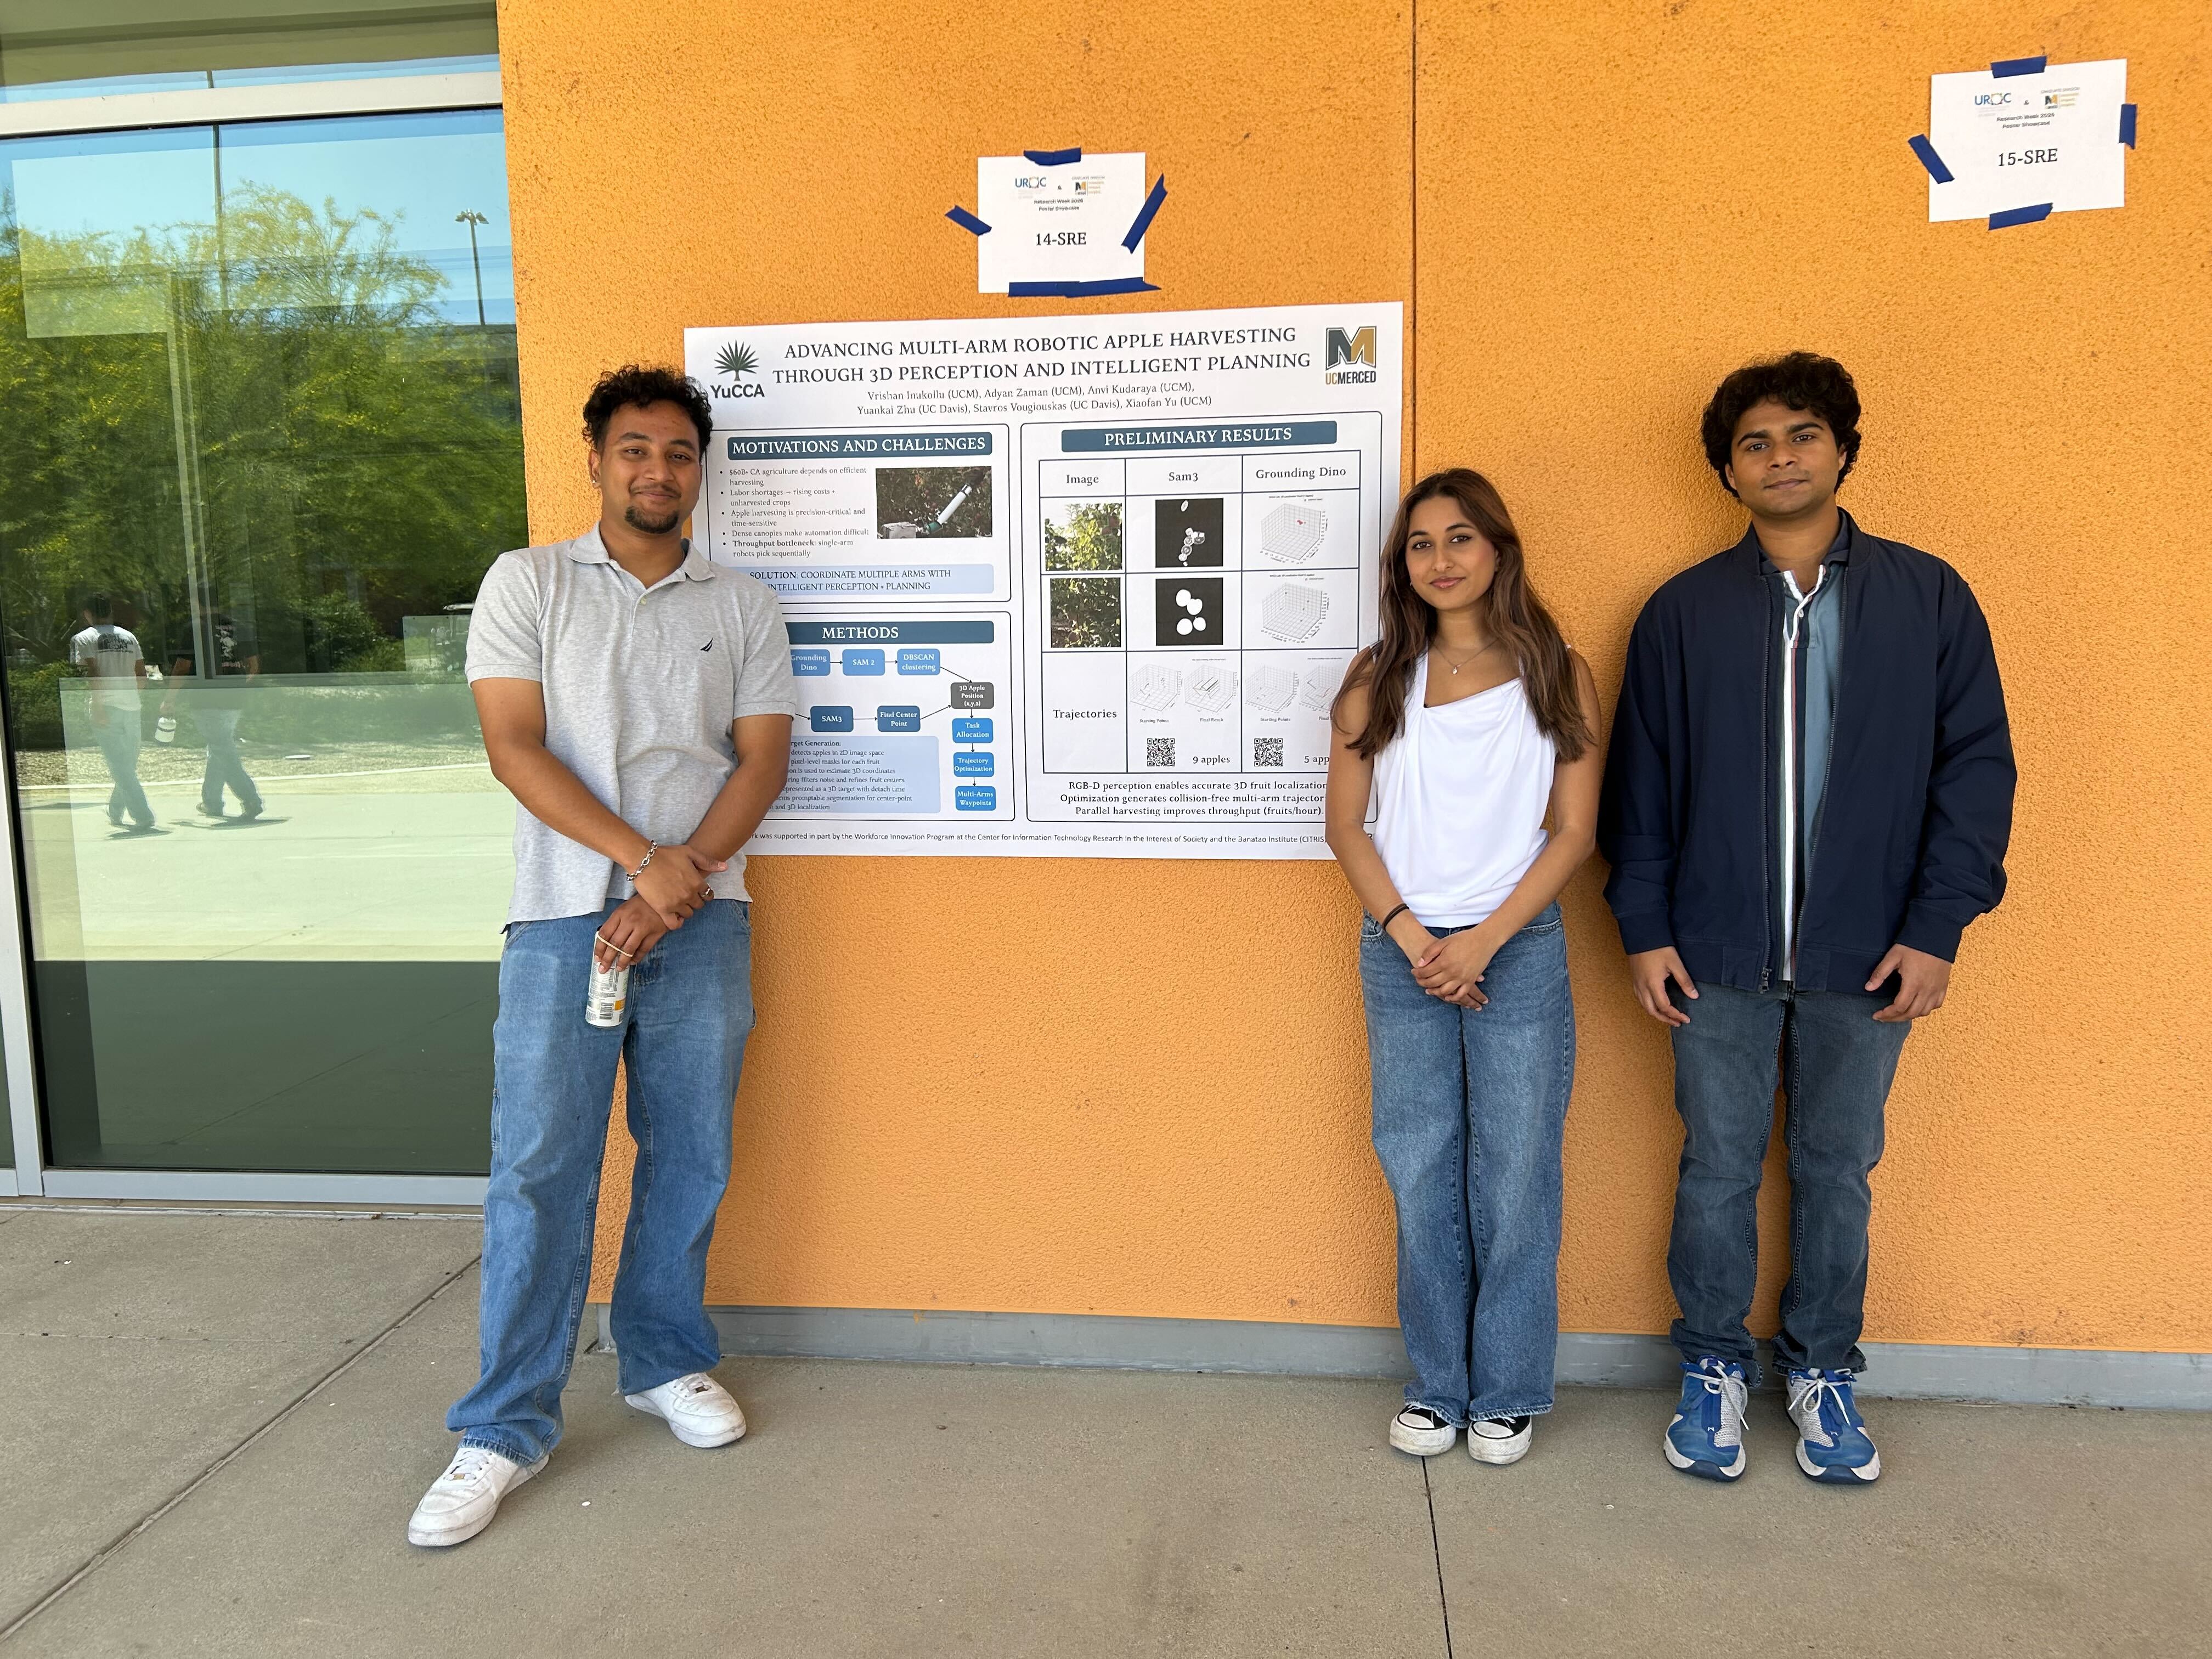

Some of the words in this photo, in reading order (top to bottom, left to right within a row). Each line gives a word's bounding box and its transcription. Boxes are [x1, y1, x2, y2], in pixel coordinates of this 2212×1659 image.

[1998, 148, 2057, 166] 15-SRE
[1036, 232, 1086, 245] 14-SRE
[784, 341, 893, 358] ADVANCING
[899, 339, 1007, 355] MULTI-ARM
[1013, 336, 1098, 352] ROBOTIC
[1103, 333, 1163, 349] APPLE
[1170, 327, 1295, 346] HARVESTING
[772, 368, 864, 383] THROUGH
[870, 367, 892, 382] 3D
[899, 364, 1018, 380] PERCEPTION
[1023, 363, 1064, 377] AND
[1070, 357, 1201, 375] INTELLIGENT
[1207, 353, 1310, 370] PLANNING
[709, 383, 765, 399] YuCCA
[867, 391, 904, 400] Vrishan
[907, 390, 944, 399] Inukollu
[948, 388, 981, 399] (UCM),
[984, 388, 1013, 400] Adyan
[1016, 388, 1047, 397] Zaman
[1051, 385, 1084, 397] (UCM),
[1087, 385, 1108, 394] Anvi
[1112, 383, 1156, 395] Kudaraya
[1160, 382, 1194, 393] (UCM),
[857, 405, 893, 415] Yuankai
[896, 404, 915, 414] Zhu
[919, 404, 936, 415] (UC
[939, 403, 970, 414] Davis),
[973, 404, 1007, 412] Stavros
[1010, 401, 1066, 414] Vougiouskas
[1070, 400, 1088, 411] (UC
[1091, 399, 1122, 409] Davis),
[1126, 397, 1161, 408] Xiaofan
[1164, 397, 1176, 406] Yu
[1180, 396, 1211, 407] (UCM)
[1104, 430, 1217, 445] PRELIMINARY
[1221, 427, 1291, 442] RESULTS
[732, 440, 838, 454] MOTIVATIONS
[842, 439, 877, 452] AND
[882, 437, 985, 451] CHALLENGES
[762, 467, 798, 477] agriculture
[800, 467, 827, 476] depends
[1169, 472, 1198, 482] Sam3
[1256, 467, 1314, 479] Grounding
[1319, 466, 1346, 476] Dino
[729, 478, 764, 487] harvesting
[1066, 474, 1098, 486] Image
[751, 488, 783, 497] shortages
[793, 488, 812, 496] rising
[731, 509, 749, 518] Apple
[752, 509, 786, 517] harvesting
[795, 507, 851, 517] precision-critical
[754, 529, 782, 538] canopies
[732, 539, 775, 549] Throughput
[818, 539, 853, 548] single-arm
[756, 550, 770, 558] pick
[772, 549, 810, 558] sequentially
[901, 569, 926, 578] ARMS
[886, 582, 930, 590] PLANNING
[822, 627, 898, 639] METHODS
[791, 654, 827, 663] Grounding
[902, 663, 935, 672] clustering
[968, 685, 985, 693] Apple
[1052, 709, 1116, 720] Trajectories
[791, 758, 820, 766] pixel-level
[957, 757, 989, 765] Trajectory
[1201, 754, 1230, 765] apples
[954, 765, 993, 773] Optimization
[1103, 782, 1152, 792] perception
[1154, 781, 1189, 789] enables
[1234, 781, 1247, 789] 3D
[1060, 794, 1119, 804] Optimization
[1122, 795, 1166, 804] generates
[1169, 793, 1229, 802] collision-free
[1233, 793, 1279, 802] multi-arm
[1075, 806, 1109, 814] Parallel
[1113, 806, 1160, 816] harvesting
[1163, 807, 1205, 817] improves
[1209, 806, 1260, 817] throughput
[1263, 806, 1324, 816] (fruits/hour).
[1054, 834, 1091, 842] Technology
